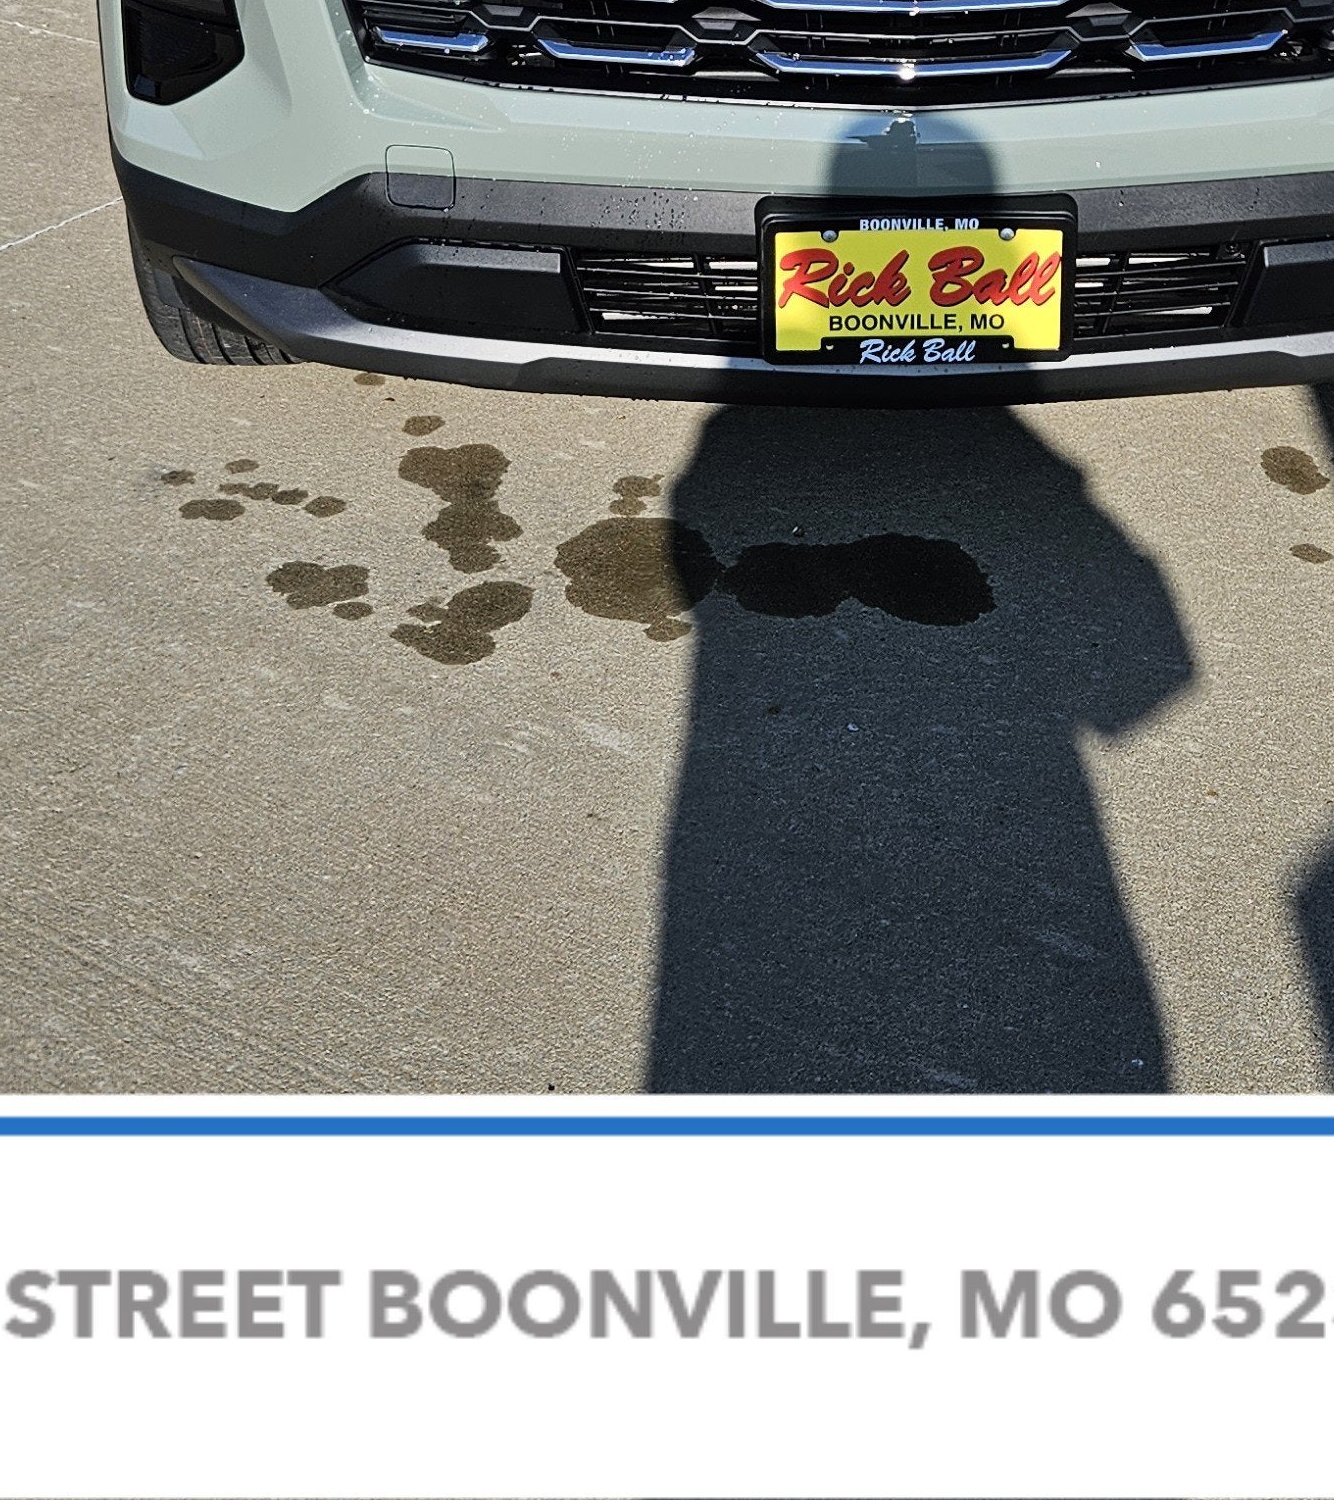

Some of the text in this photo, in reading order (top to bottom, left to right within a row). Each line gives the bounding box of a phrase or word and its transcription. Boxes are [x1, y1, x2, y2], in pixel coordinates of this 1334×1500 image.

[859, 218, 980, 231] BOONVILLE, MO
[778, 246, 1062, 309] Rick Ball
[829, 313, 1005, 333] BOONVILLE, MO
[859, 338, 976, 363] Rick Ball
